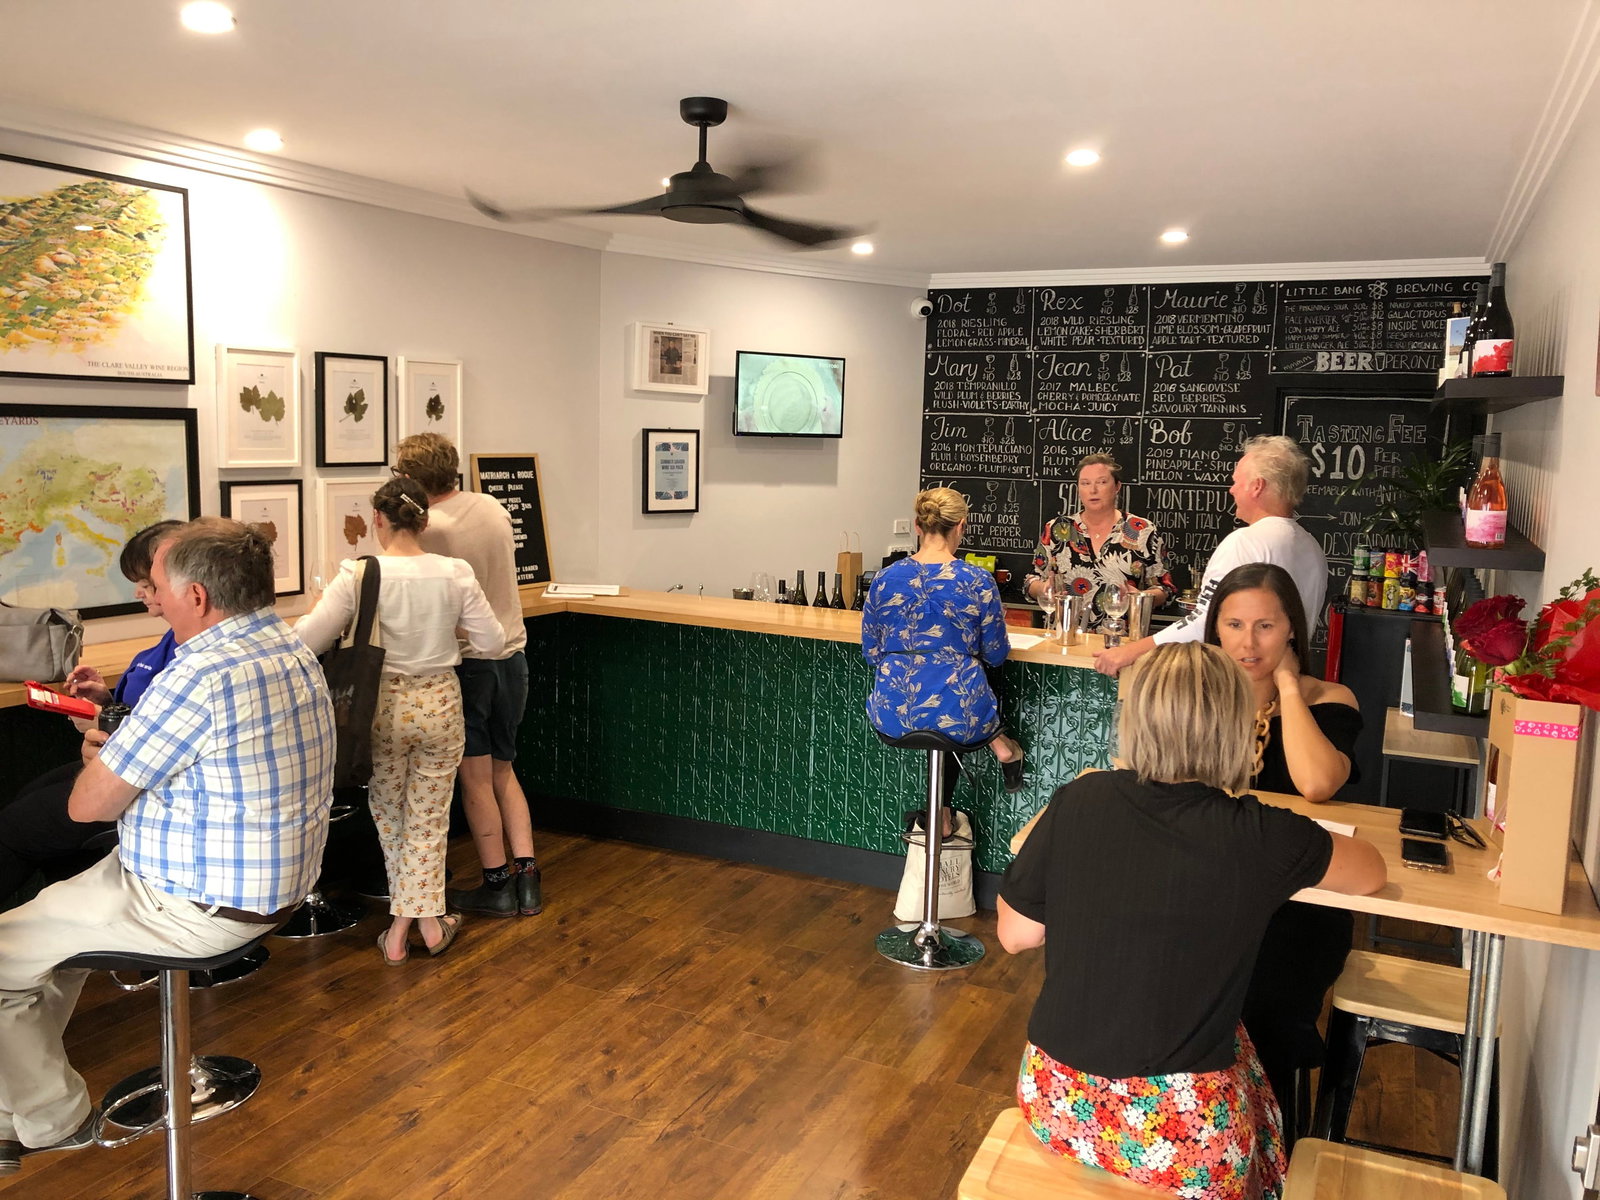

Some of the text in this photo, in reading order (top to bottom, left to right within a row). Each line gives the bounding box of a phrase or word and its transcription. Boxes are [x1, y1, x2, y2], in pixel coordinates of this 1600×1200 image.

[1286, 287, 1328, 296] LITTLE
[1334, 285, 1363, 295] BANG
[1396, 283, 1454, 293] BREWING
[938, 293, 972, 313] Dot
[1040, 289, 1084, 311] Rex
[1153, 289, 1268, 314] Maurie $10 $25
[1040, 315, 1134, 325] 2018 WILD RIESLING
[1155, 314, 1244, 324] 2018 VERMENTINO
[1388, 310, 1447, 319] GALACTOPUS
[937, 318, 1008, 328] 2018 RIESLING
[1388, 319, 1446, 330] INSIDE VOICE
[997, 327, 1024, 336] APPLE
[1094, 325, 1146, 335] SHERBERT
[1153, 325, 1174, 334] LIME
[1177, 325, 1219, 334] BLOSSOM
[1040, 336, 1067, 346] WHITE
[1072, 336, 1095, 345] PEAR
[1152, 334, 1260, 345] APPLE TART TEXTURED
[1315, 351, 1437, 371] BEER PERONI
[928, 354, 1021, 382] Mary $10 $28
[1037, 353, 1132, 382] Jean $10 $28
[1155, 353, 1252, 381] Pat $10 $25
[934, 381, 1017, 391] 2018 TEMPRANILLO
[1039, 382, 1119, 392] 2017 MALBEC
[1179, 383, 1241, 393] SANGIOVESE
[934, 391, 954, 400] WILD
[957, 391, 977, 399] PLUM
[986, 391, 1021, 400] BERRIES
[1037, 392, 1074, 401] CHERRY
[1081, 393, 1141, 402] POMEGRANATE
[1153, 394, 1226, 403] RED BERRIES
[1038, 402, 1119, 412] MOCHA JUICY
[1151, 403, 1247, 414] SAVOURY TANNINS
[930, 416, 1015, 445] Jim $10 $28
[1038, 418, 1134, 445] Alice $10 $28
[1296, 413, 1427, 444] TASTING FEE
[1149, 418, 1193, 445] Bob
[1218, 443, 1233, 452] $10
[931, 442, 1032, 455] 2016 MONTEPULCIANO
[1043, 444, 1068, 455] 2016
[1146, 447, 1174, 458] 2019
[931, 452, 951, 461] PLUM
[960, 453, 1019, 464] BOYSENBERRY
[1043, 456, 1075, 466] PLUM
[1311, 442, 1401, 480] $10 PER
[929, 463, 972, 472] OREGANO
[1145, 459, 1202, 471] PINEAPPLE
[1043, 467, 1061, 476] INK
[1145, 470, 1229, 483] MELON WAXY
[982, 502, 1020, 513] $10 $25
[1195, 513, 1222, 530] ITALY
[1339, 511, 1361, 526] JOIN
[989, 526, 1021, 537] PEPPER
[980, 537, 1034, 549] WATERMELON
[1185, 532, 1219, 551] PIZZA
[1175, 554, 1189, 565] $10
